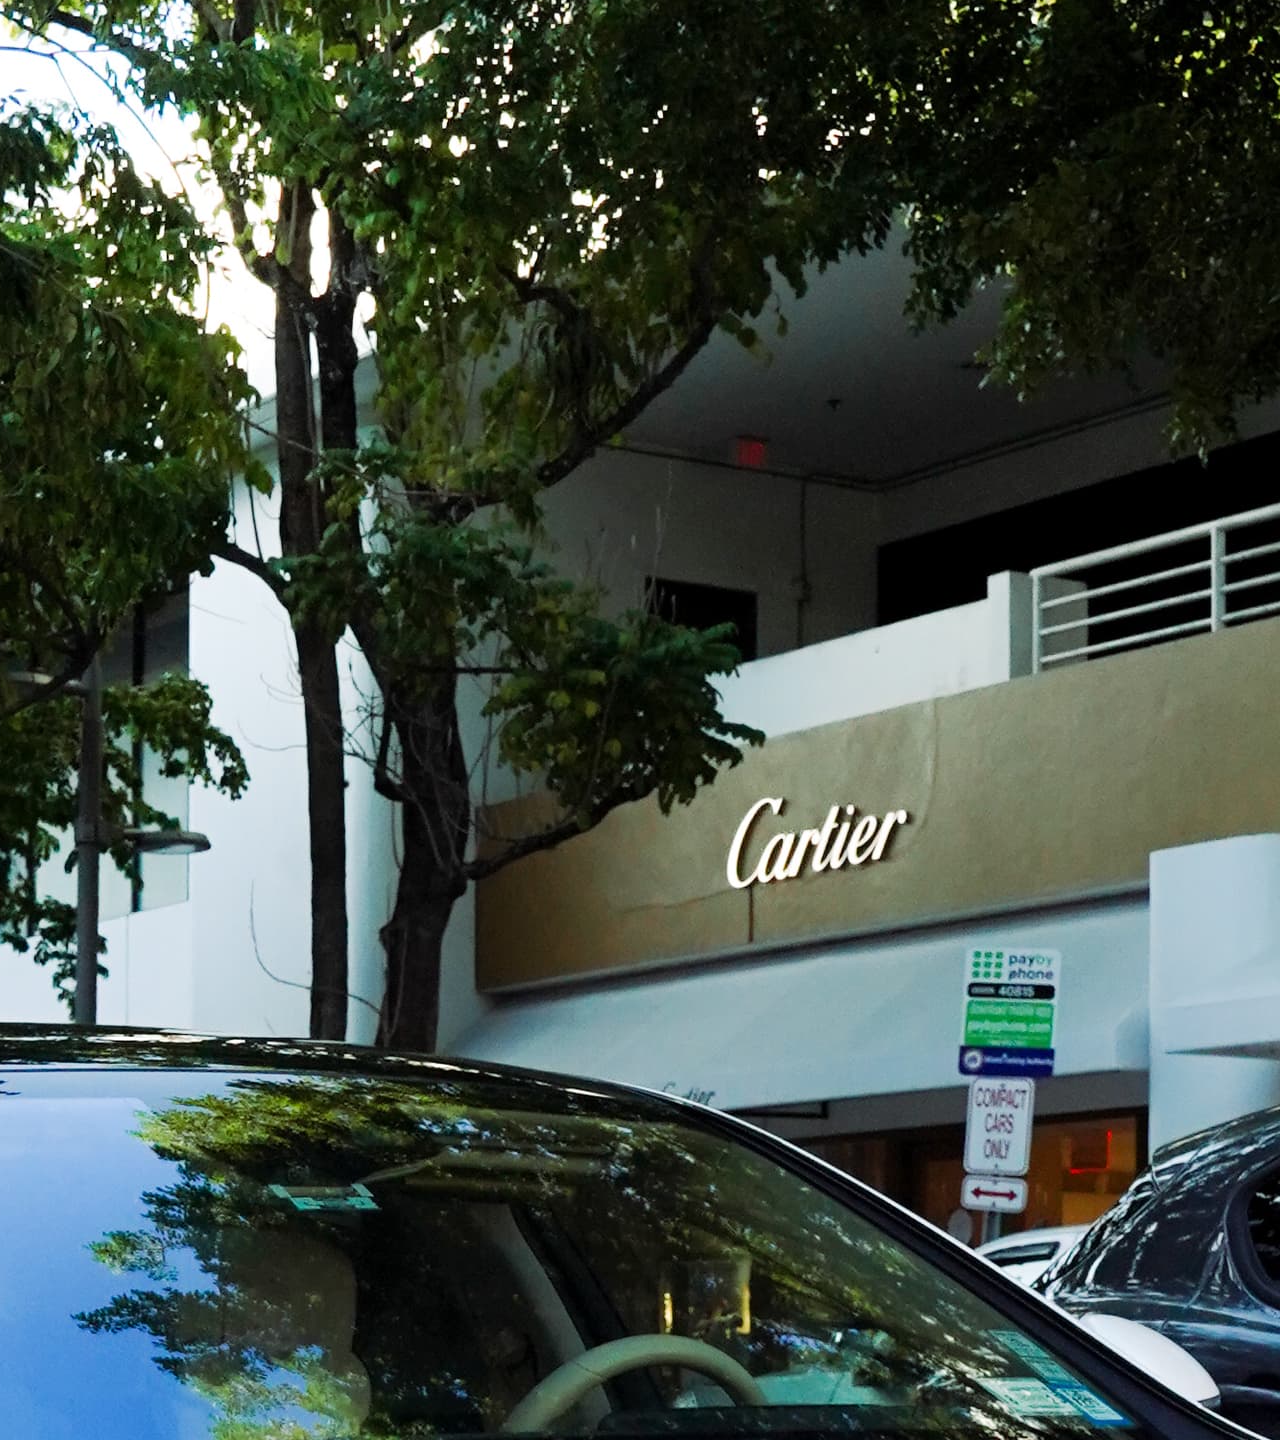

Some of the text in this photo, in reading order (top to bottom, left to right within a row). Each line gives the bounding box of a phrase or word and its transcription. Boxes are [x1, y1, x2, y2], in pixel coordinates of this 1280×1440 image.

[727, 797, 907, 889] Cartier
[1007, 968, 1053, 981] phone
[976, 1087, 1027, 1110] COMPACT
[985, 1113, 1014, 1134] CARS
[984, 1139, 1009, 1159] ONLY
